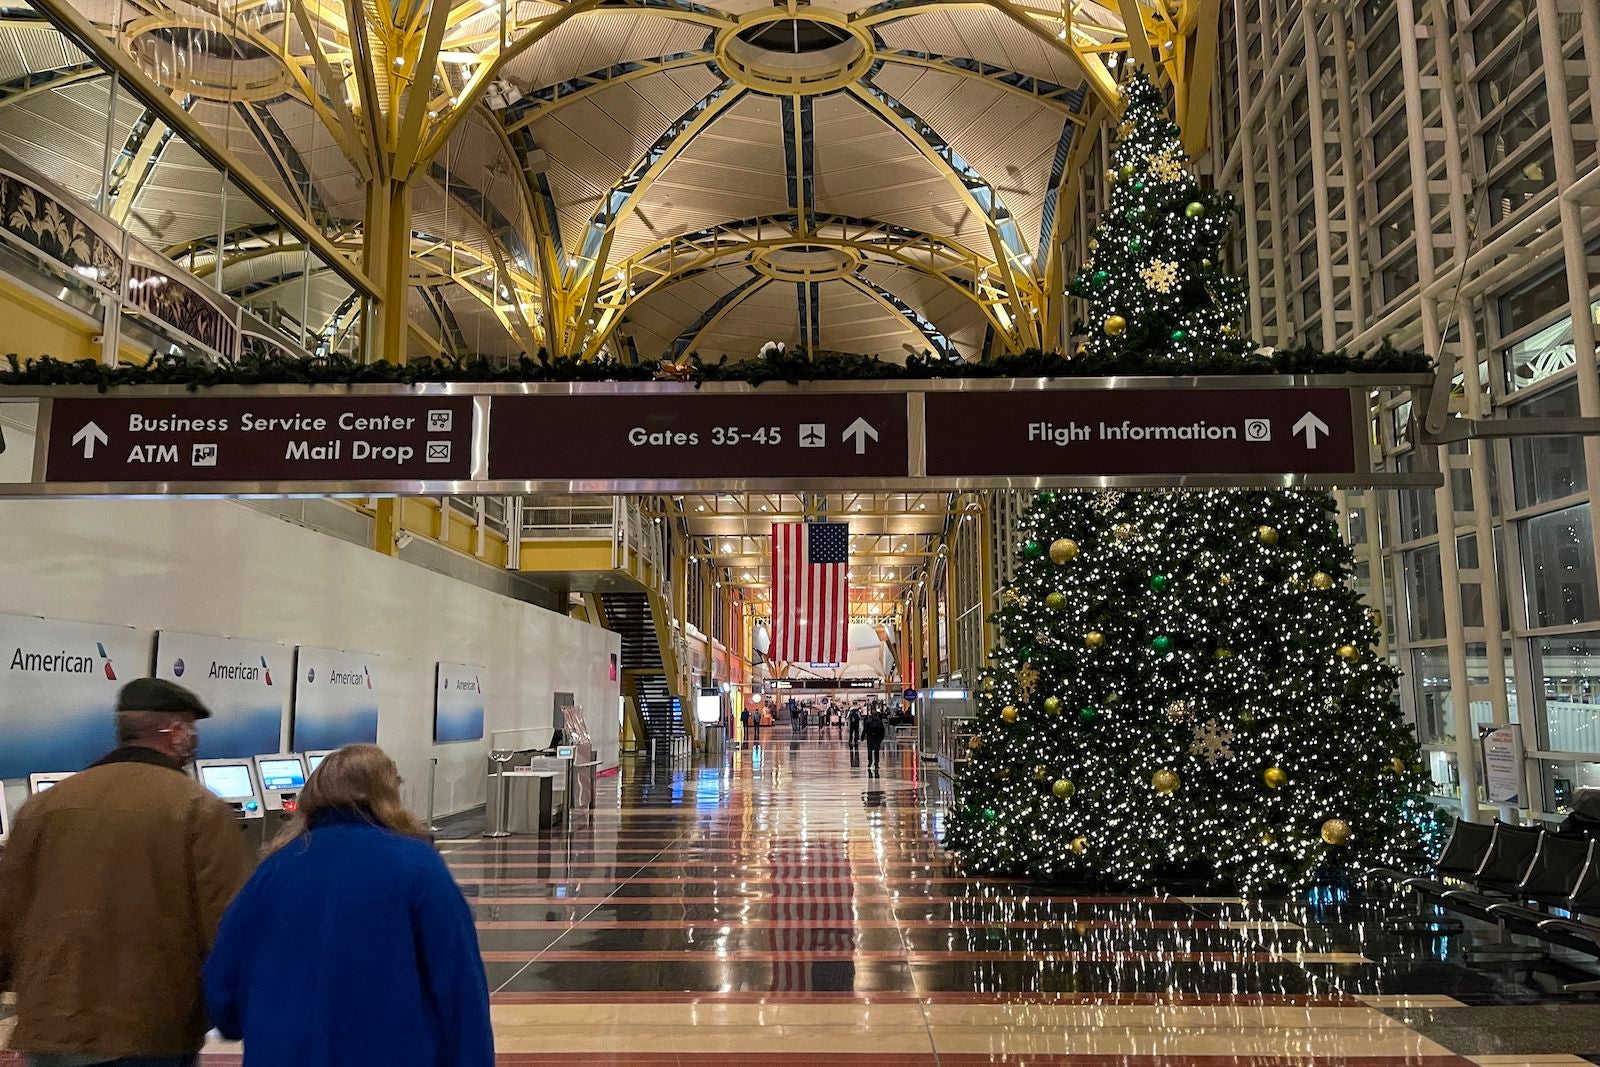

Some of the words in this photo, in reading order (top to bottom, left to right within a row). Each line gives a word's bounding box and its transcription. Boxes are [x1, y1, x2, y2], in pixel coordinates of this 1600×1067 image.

[128, 413, 229, 432] Business
[240, 412, 327, 431] Service
[338, 412, 416, 431] Center
[628, 427, 699, 447] Gates
[711, 426, 782, 445] 35-45
[1028, 421, 1092, 447] Flight
[1099, 420, 1238, 440] Information
[126, 444, 180, 463] ATM
[285, 440, 341, 460] Mail
[352, 440, 414, 465] Drop
[10, 647, 93, 674] American
[208, 660, 259, 681] American
[329, 669, 363, 686] American
